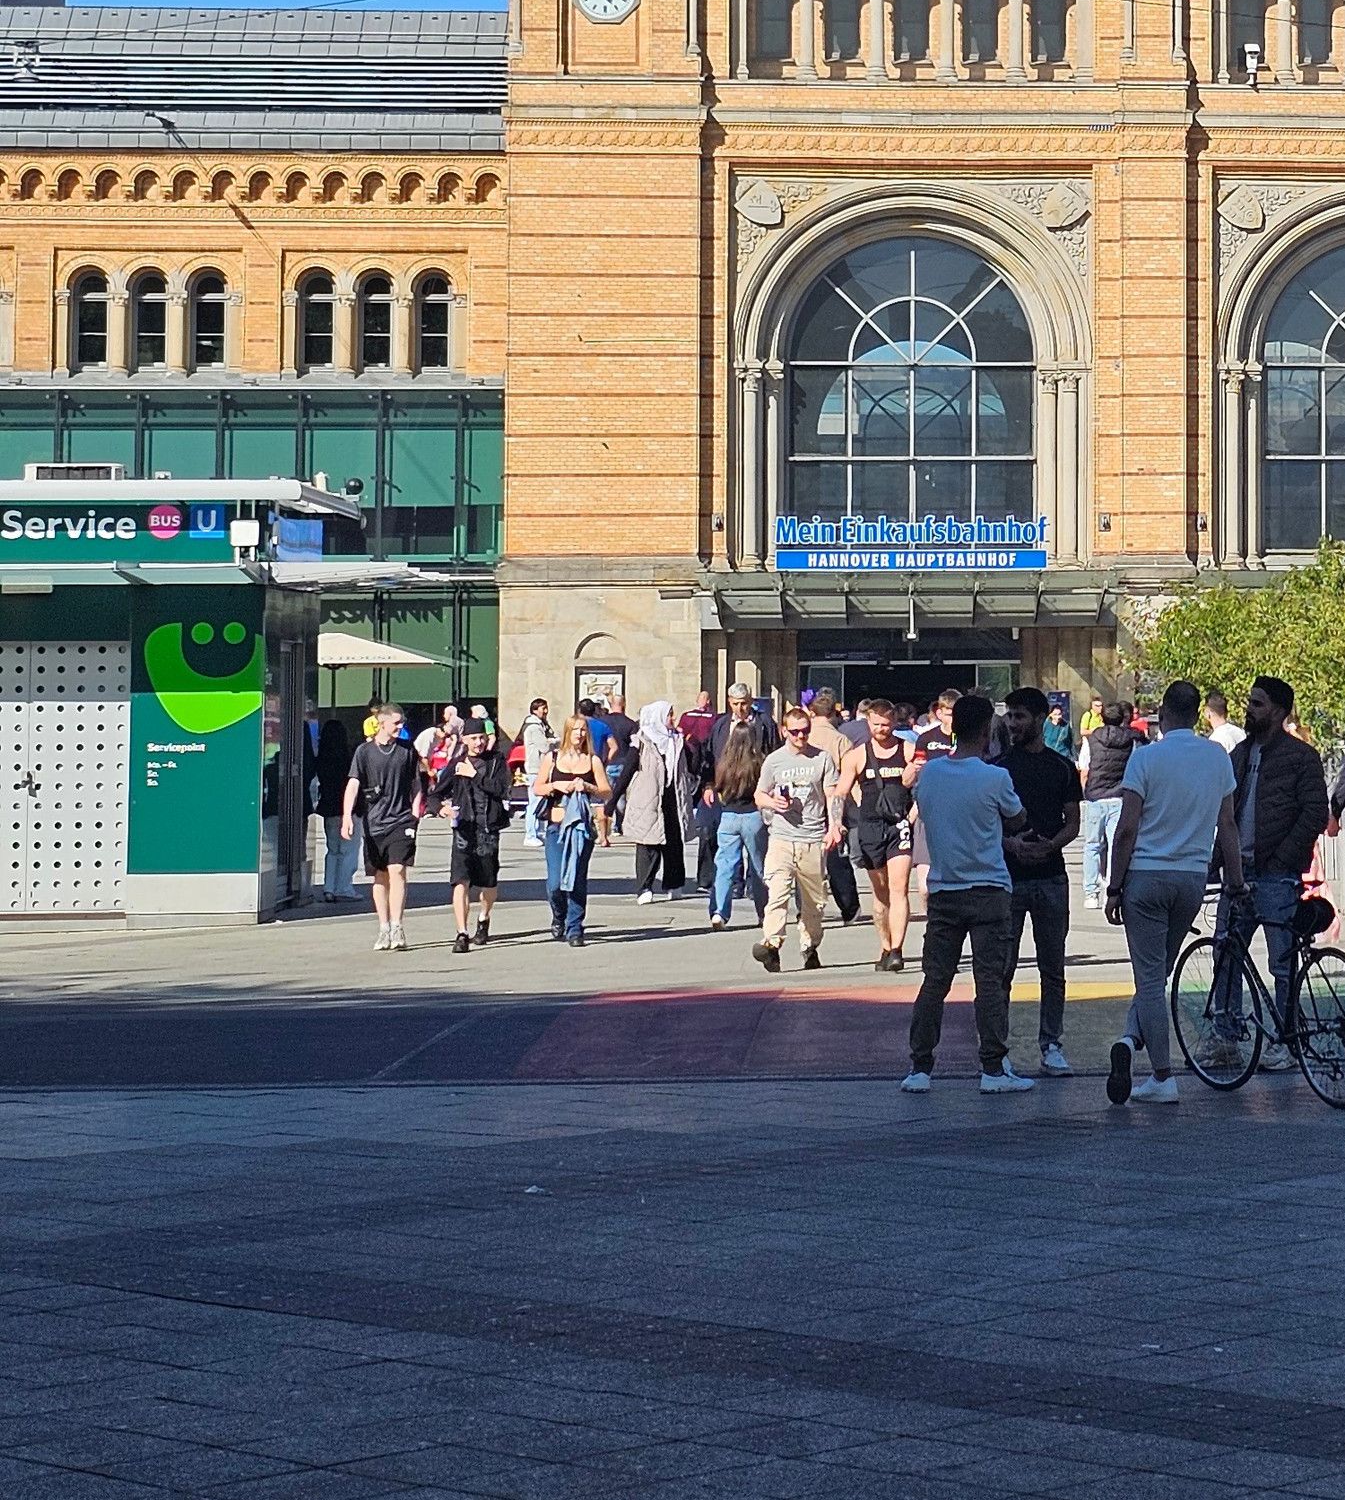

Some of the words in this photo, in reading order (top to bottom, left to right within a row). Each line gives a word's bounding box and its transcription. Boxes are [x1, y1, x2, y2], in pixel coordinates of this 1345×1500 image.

[1, 510, 136, 539] Service
[150, 515, 181, 527] BUS
[197, 509, 216, 532] U
[776, 516, 834, 543] Mein
[841, 514, 1047, 544] Einkaufsbahnhof
[808, 552, 890, 567] HANNOVER
[896, 552, 1016, 567] HAUPTBAHNHOF
[147, 743, 206, 753] Servicepoint
